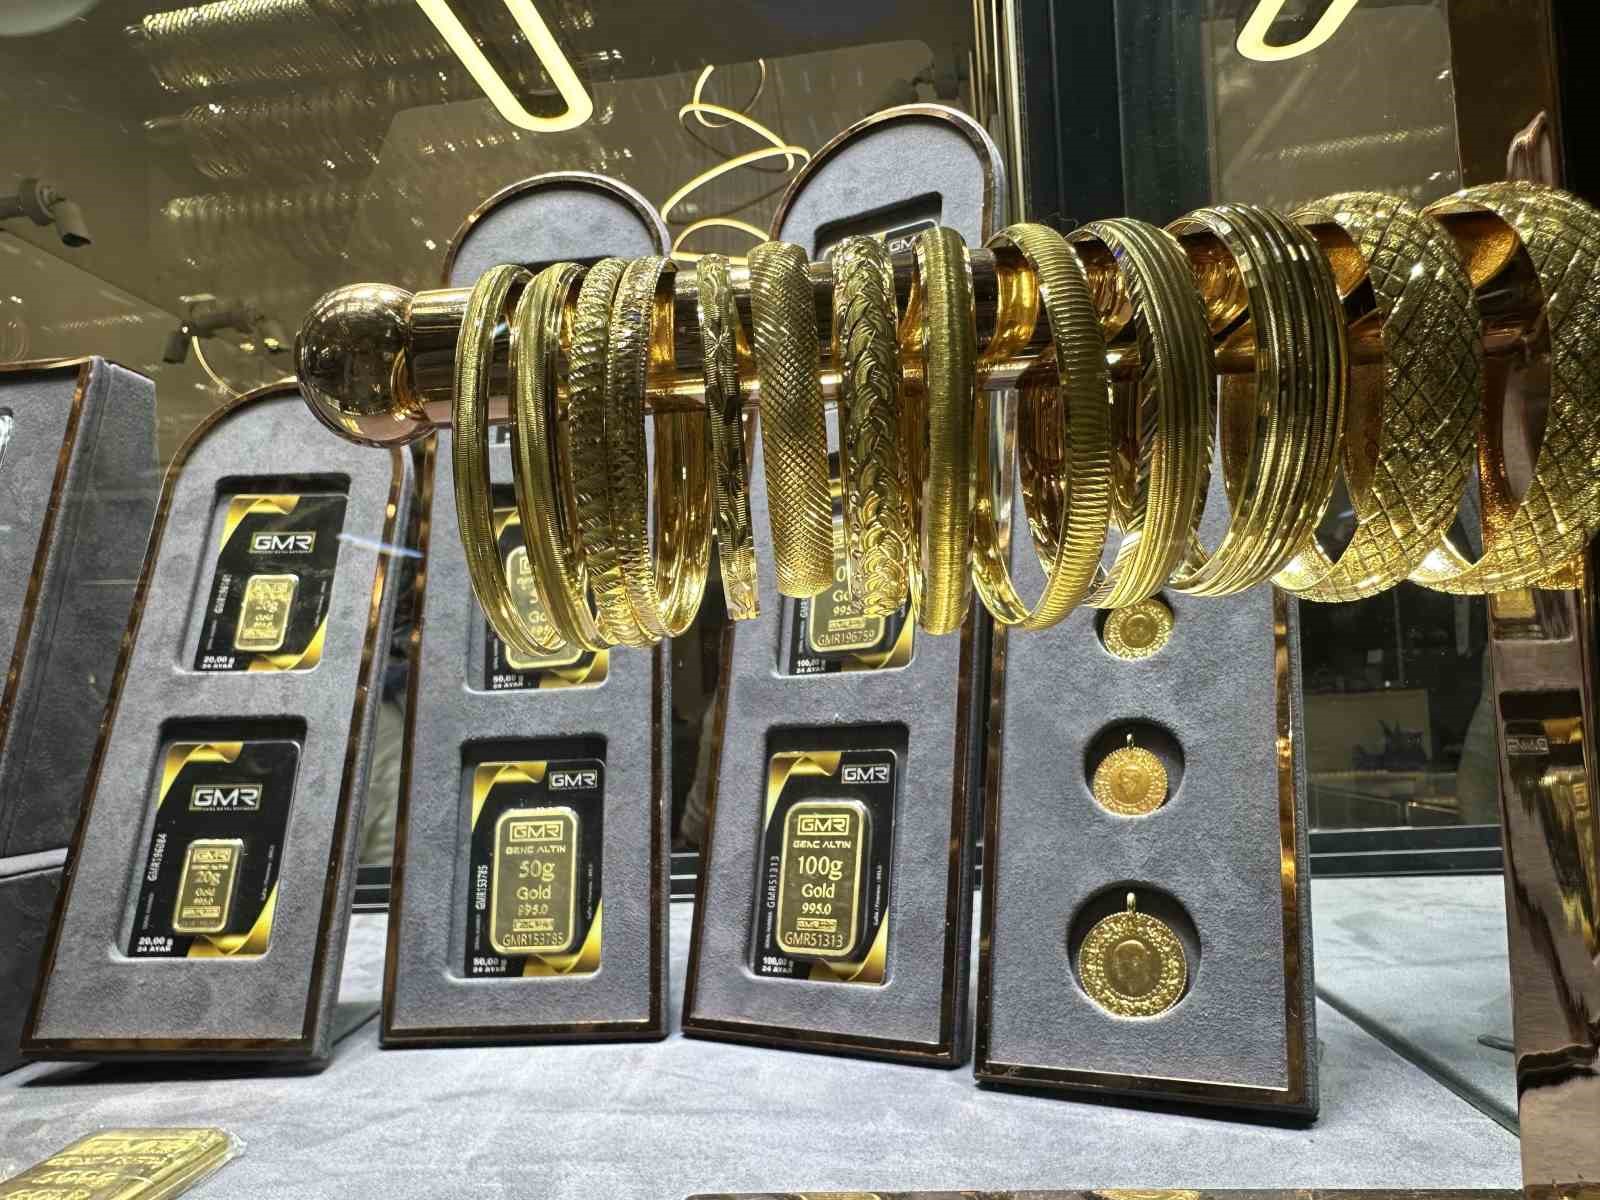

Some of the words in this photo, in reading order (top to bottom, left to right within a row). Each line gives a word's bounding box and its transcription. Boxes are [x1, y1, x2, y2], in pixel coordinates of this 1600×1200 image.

[255, 535, 313, 550] GMR
[551, 773, 596, 787] GMR
[844, 767, 889, 780] GMR
[193, 788, 258, 807] GMR
[514, 825, 560, 839] GMR
[801, 817, 847, 832] GMR
[822, 840, 852, 849] ALTIN
[519, 859, 556, 882] 50g
[797, 855, 844, 881] 100g
[767, 855, 780, 908] GMR51313
[516, 885, 552, 900] Gold
[801, 882, 836, 898] Gold
[801, 902, 832, 915] 995.0
[784, 931, 844, 948] GMR51313
